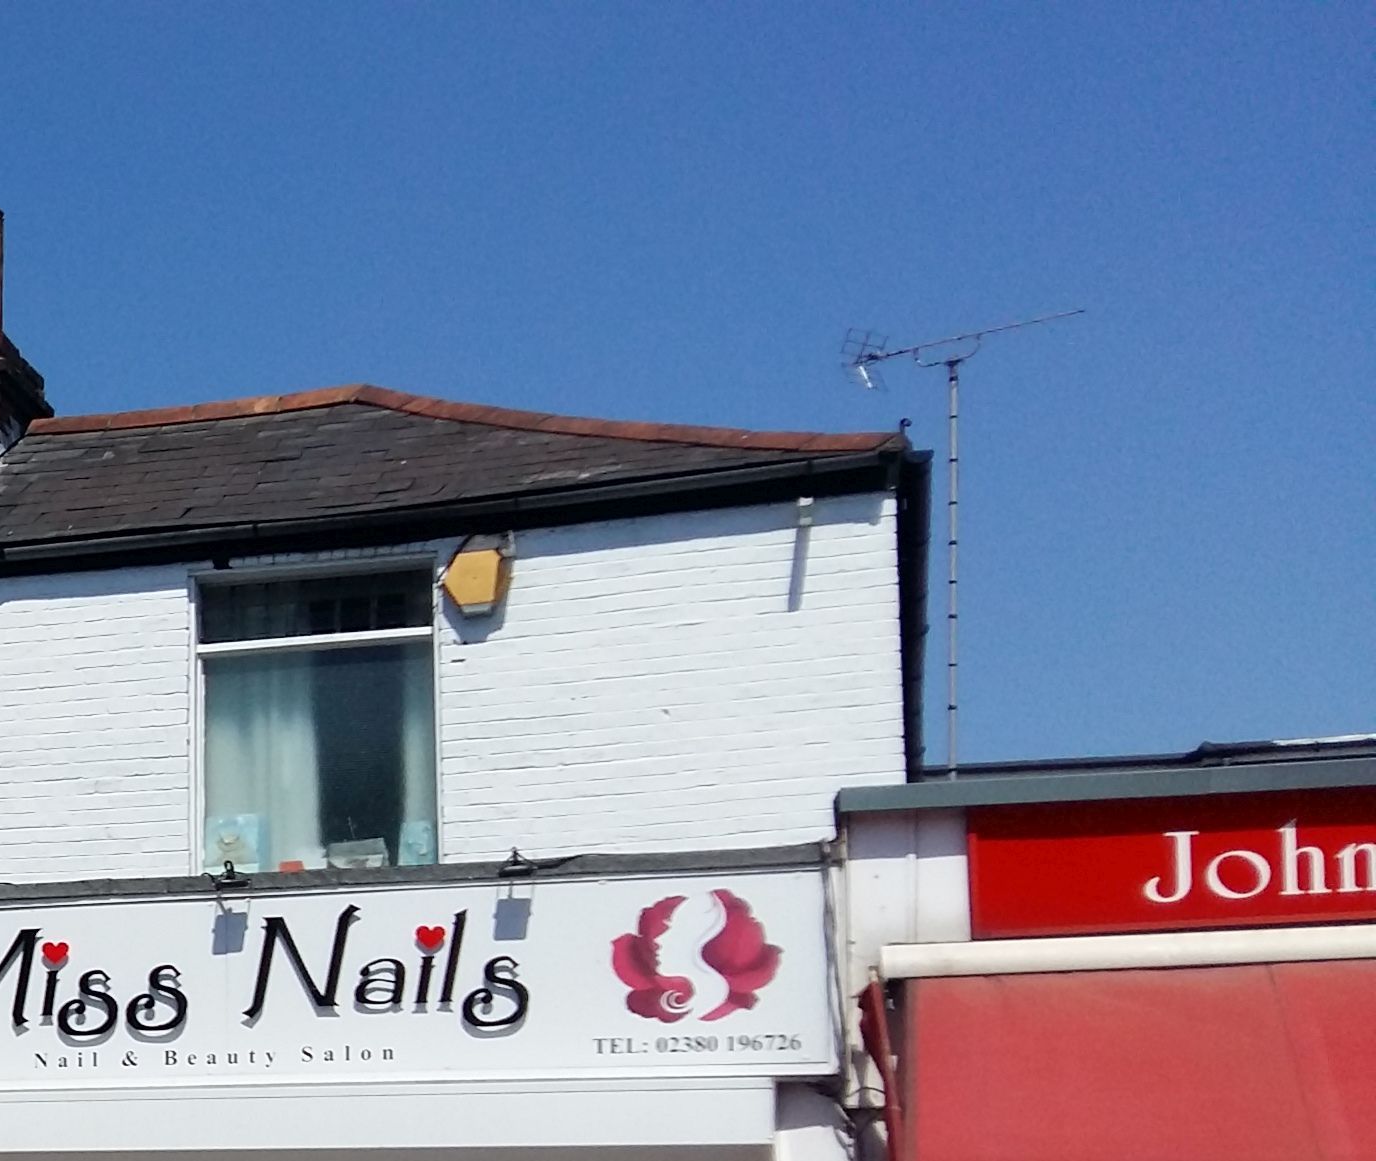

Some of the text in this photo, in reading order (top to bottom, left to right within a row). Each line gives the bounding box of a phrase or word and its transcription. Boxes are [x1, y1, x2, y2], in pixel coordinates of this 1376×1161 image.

[1144, 819, 1376, 903] John
[241, 903, 530, 1032] Nails
[33, 1045, 395, 1069] Nail & Beauty Salon
[592, 1033, 803, 1055] TEL: 02380 196726
